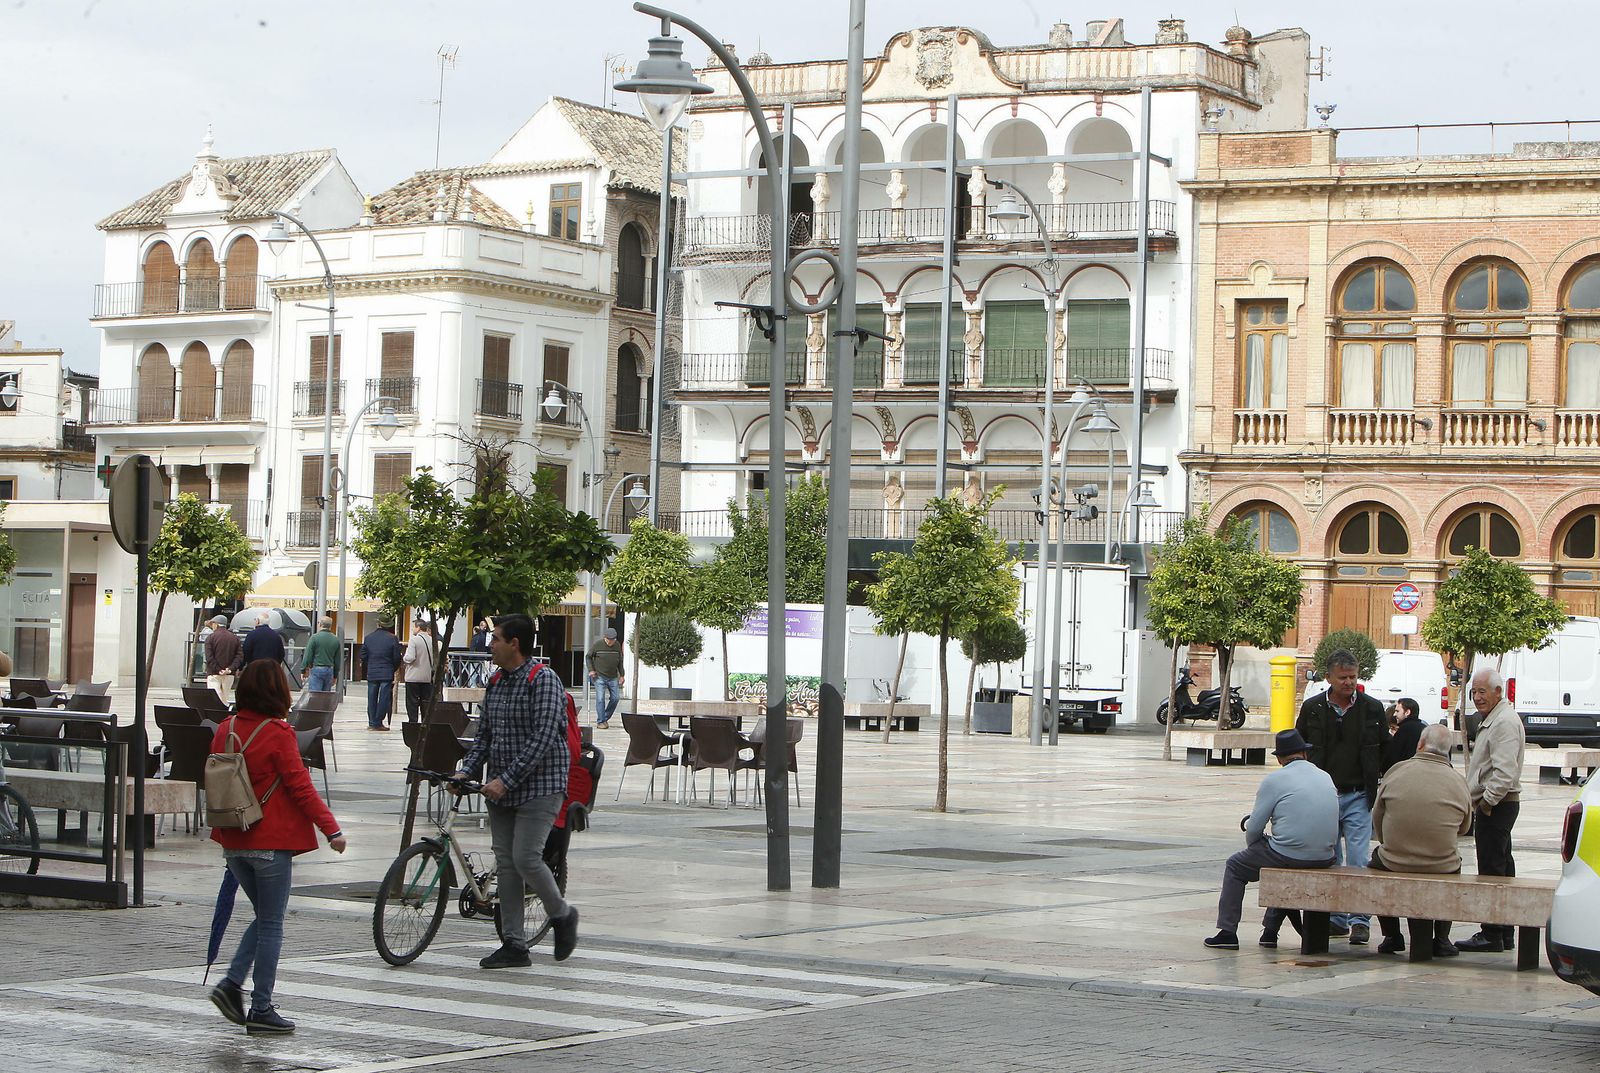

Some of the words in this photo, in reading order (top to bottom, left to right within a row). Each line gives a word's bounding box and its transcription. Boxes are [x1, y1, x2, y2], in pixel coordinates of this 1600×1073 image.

[284, 599, 296, 608] BAR
[326, 599, 352, 609] PUEAS
[735, 680, 768, 699] Casta
